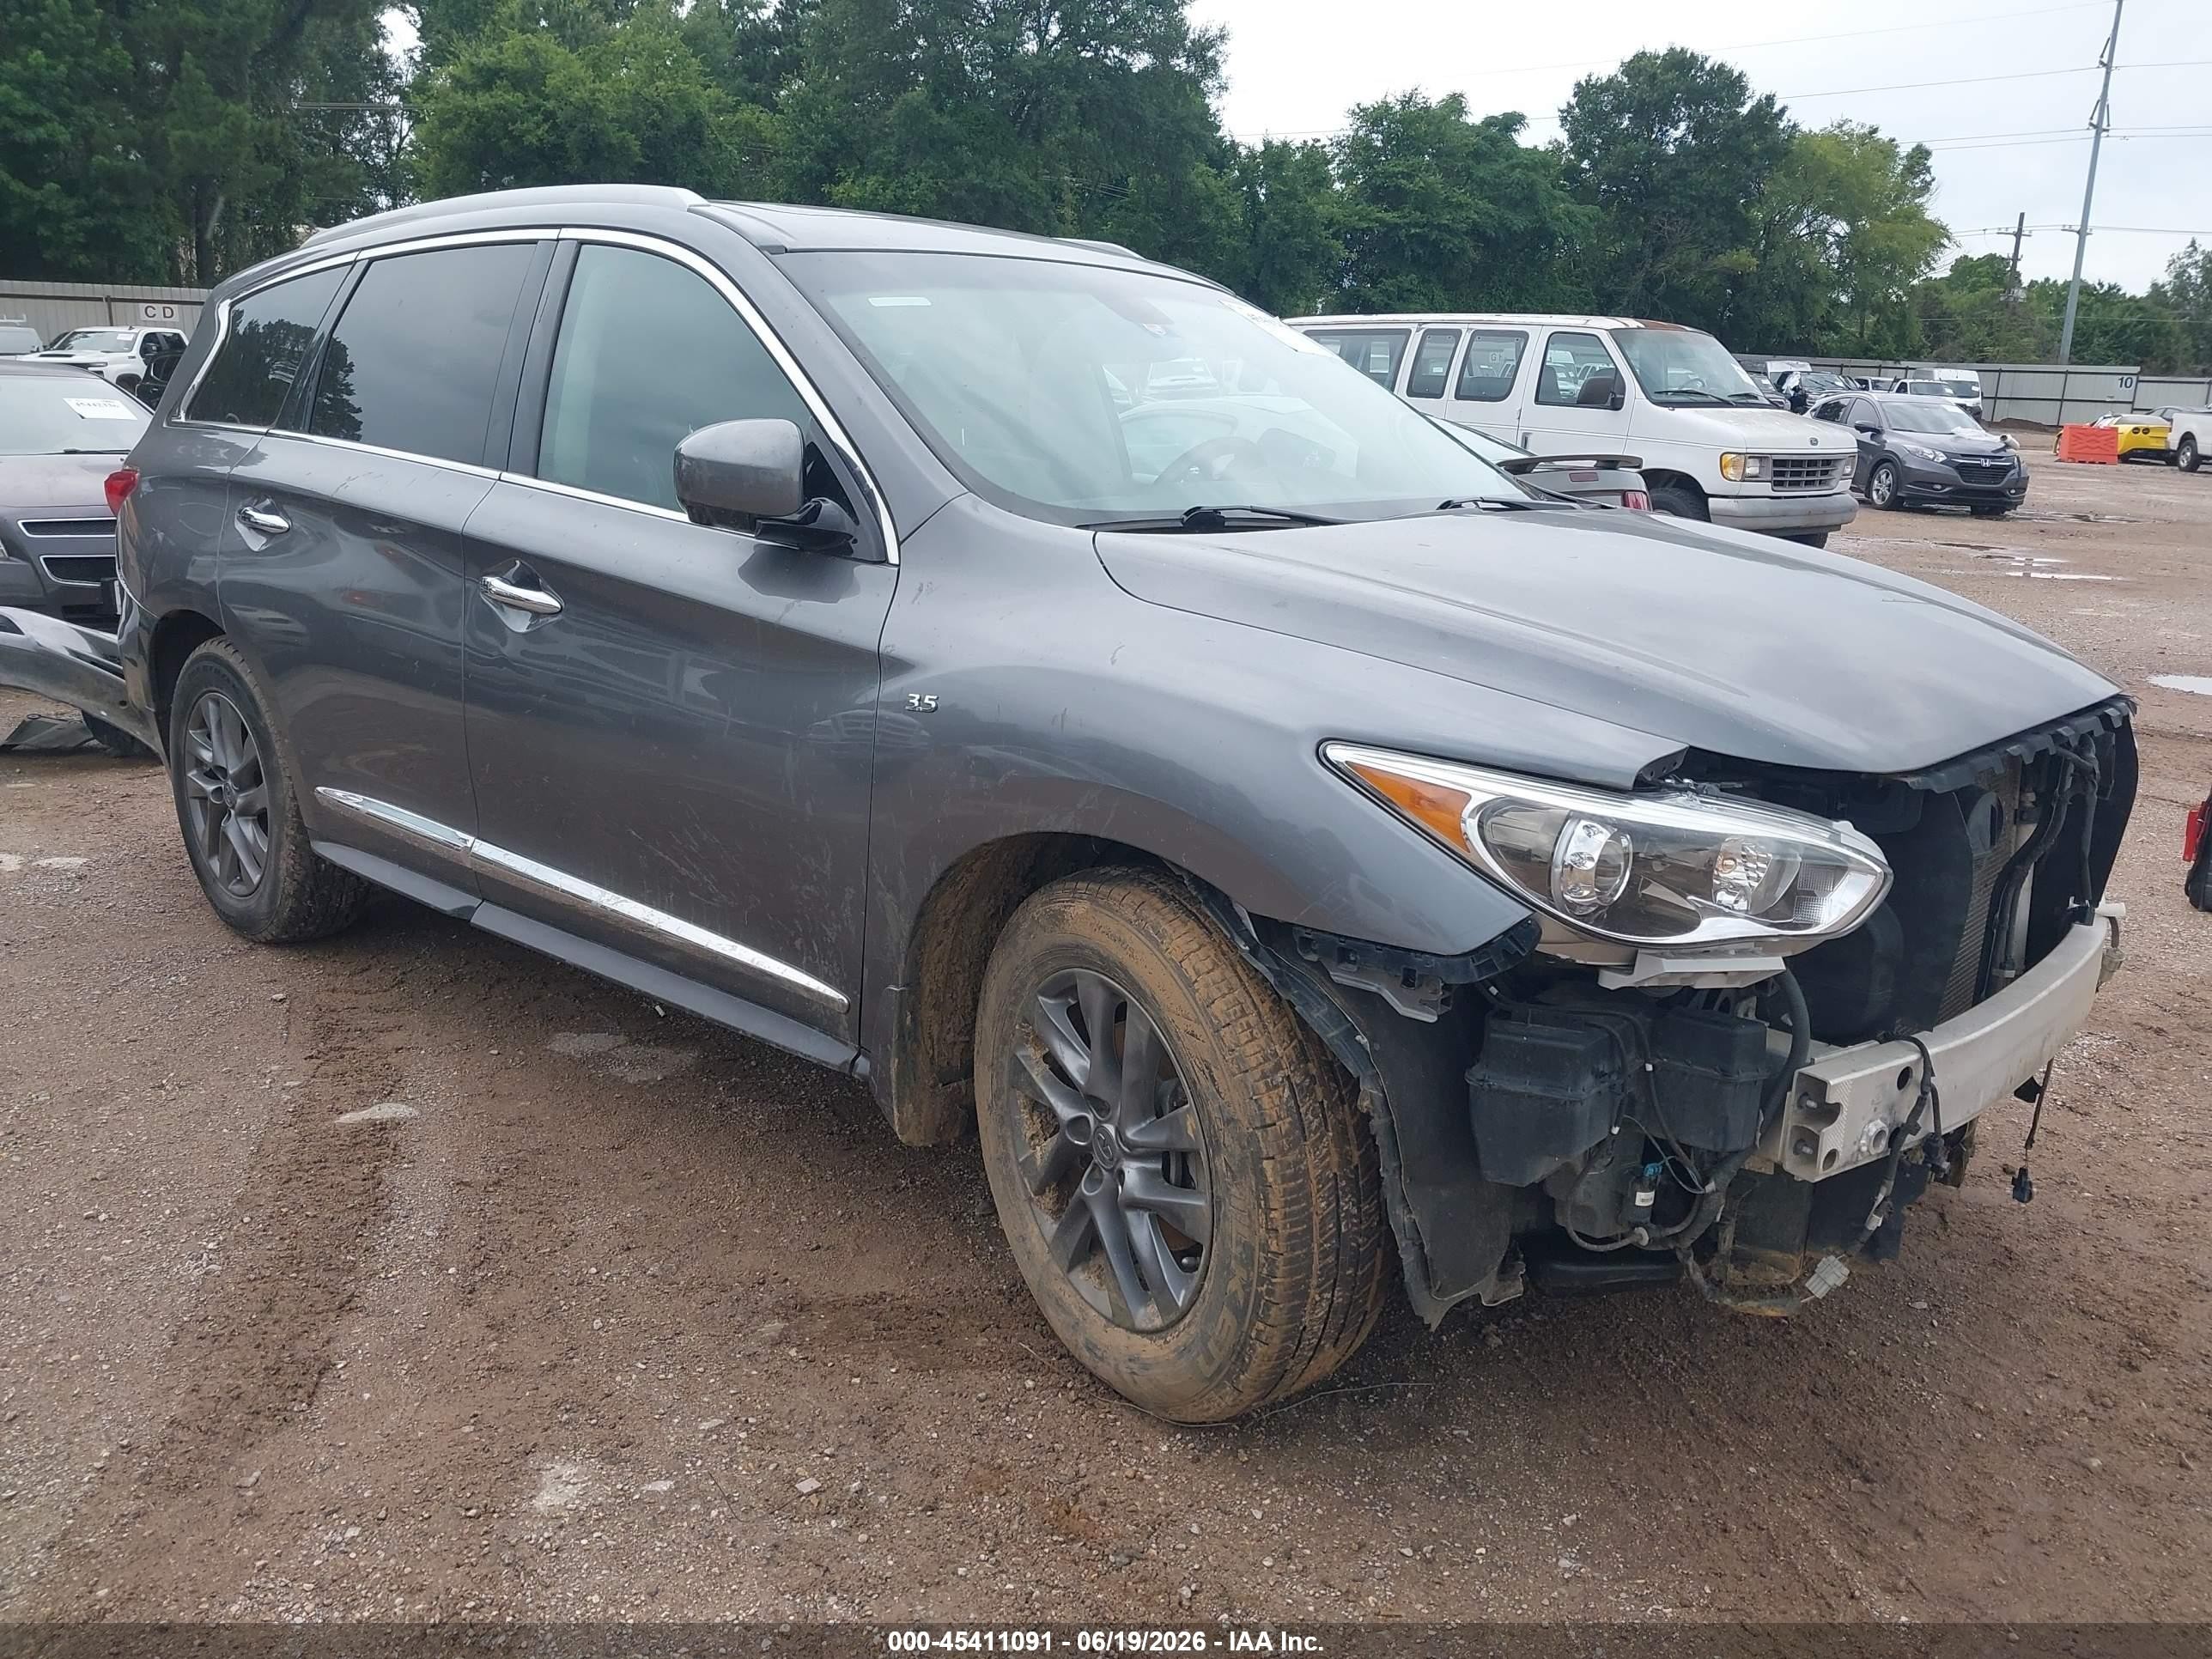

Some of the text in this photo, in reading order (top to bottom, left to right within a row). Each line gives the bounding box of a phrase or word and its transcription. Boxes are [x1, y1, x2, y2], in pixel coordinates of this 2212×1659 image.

[144, 306, 174, 319] C D
[2118, 377, 2133, 388] 10
